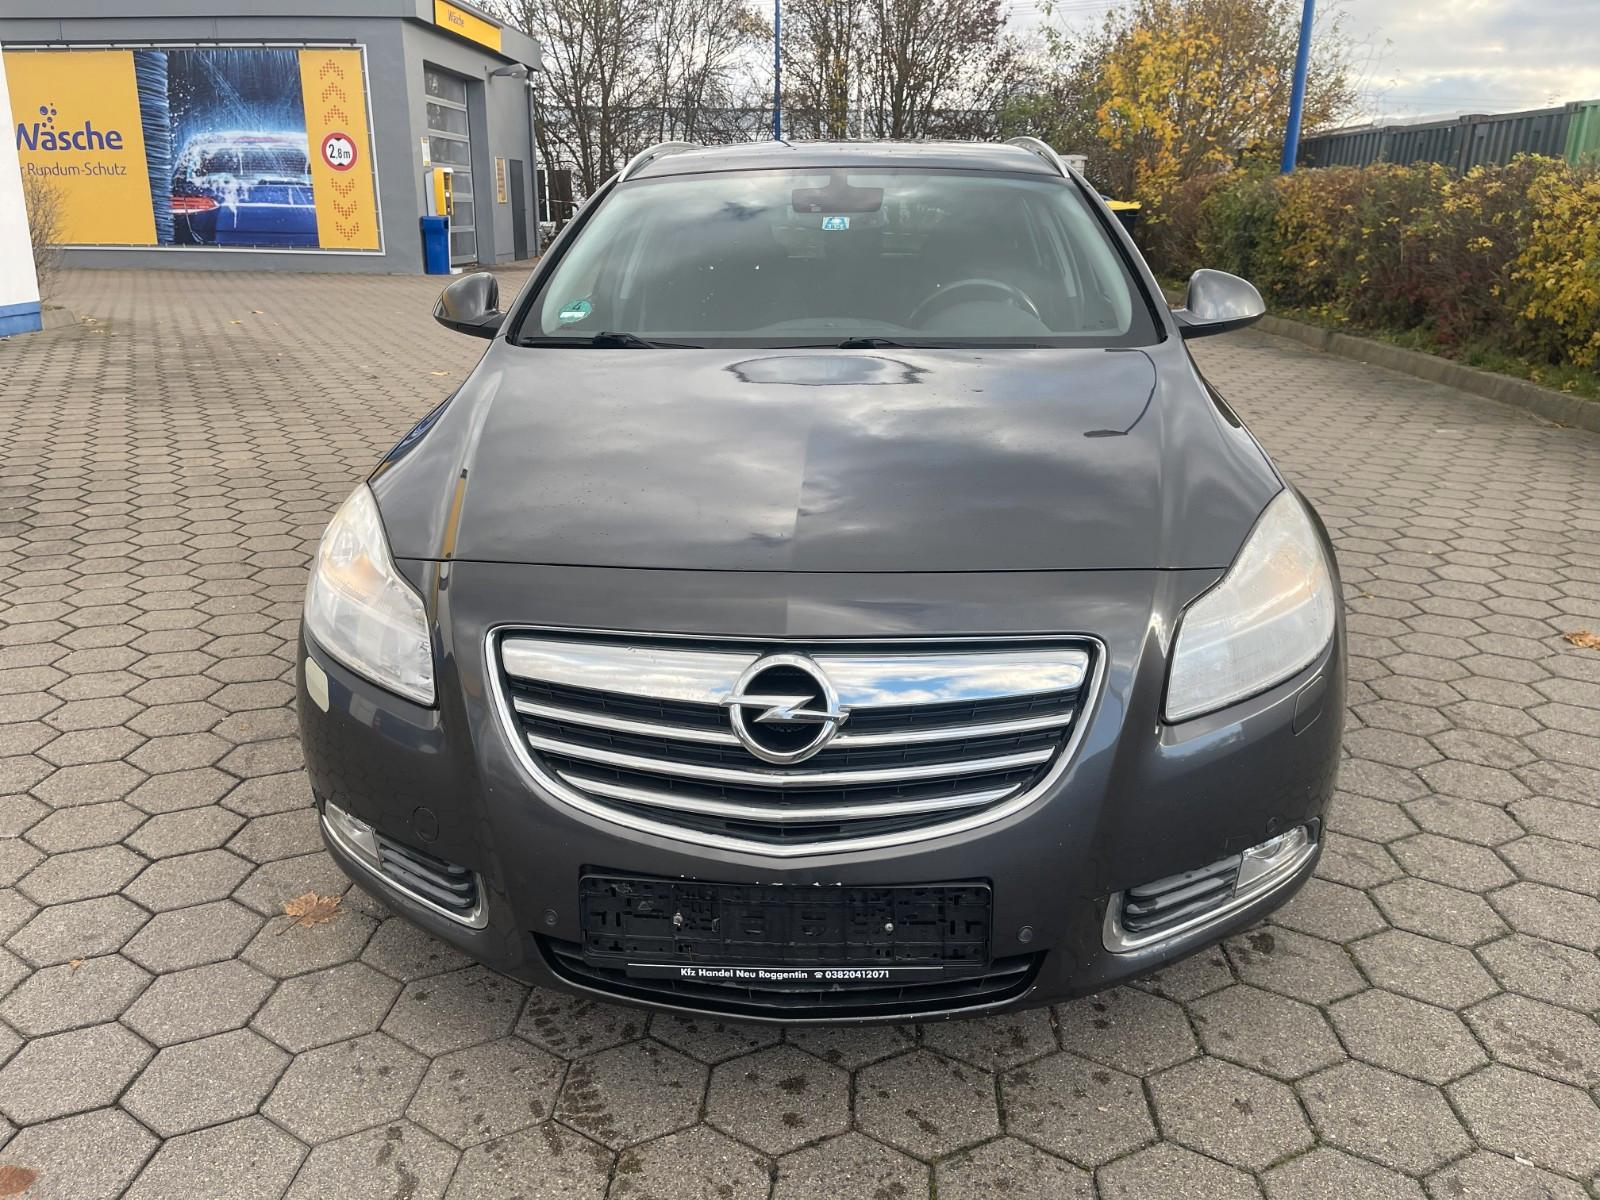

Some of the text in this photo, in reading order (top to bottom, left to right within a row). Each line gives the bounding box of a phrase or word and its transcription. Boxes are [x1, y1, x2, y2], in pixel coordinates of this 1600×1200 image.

[27, 161, 127, 176] Rundum-Schutz
[680, 967, 889, 980] Kfz Handel Neu Roggentin 03820412071
